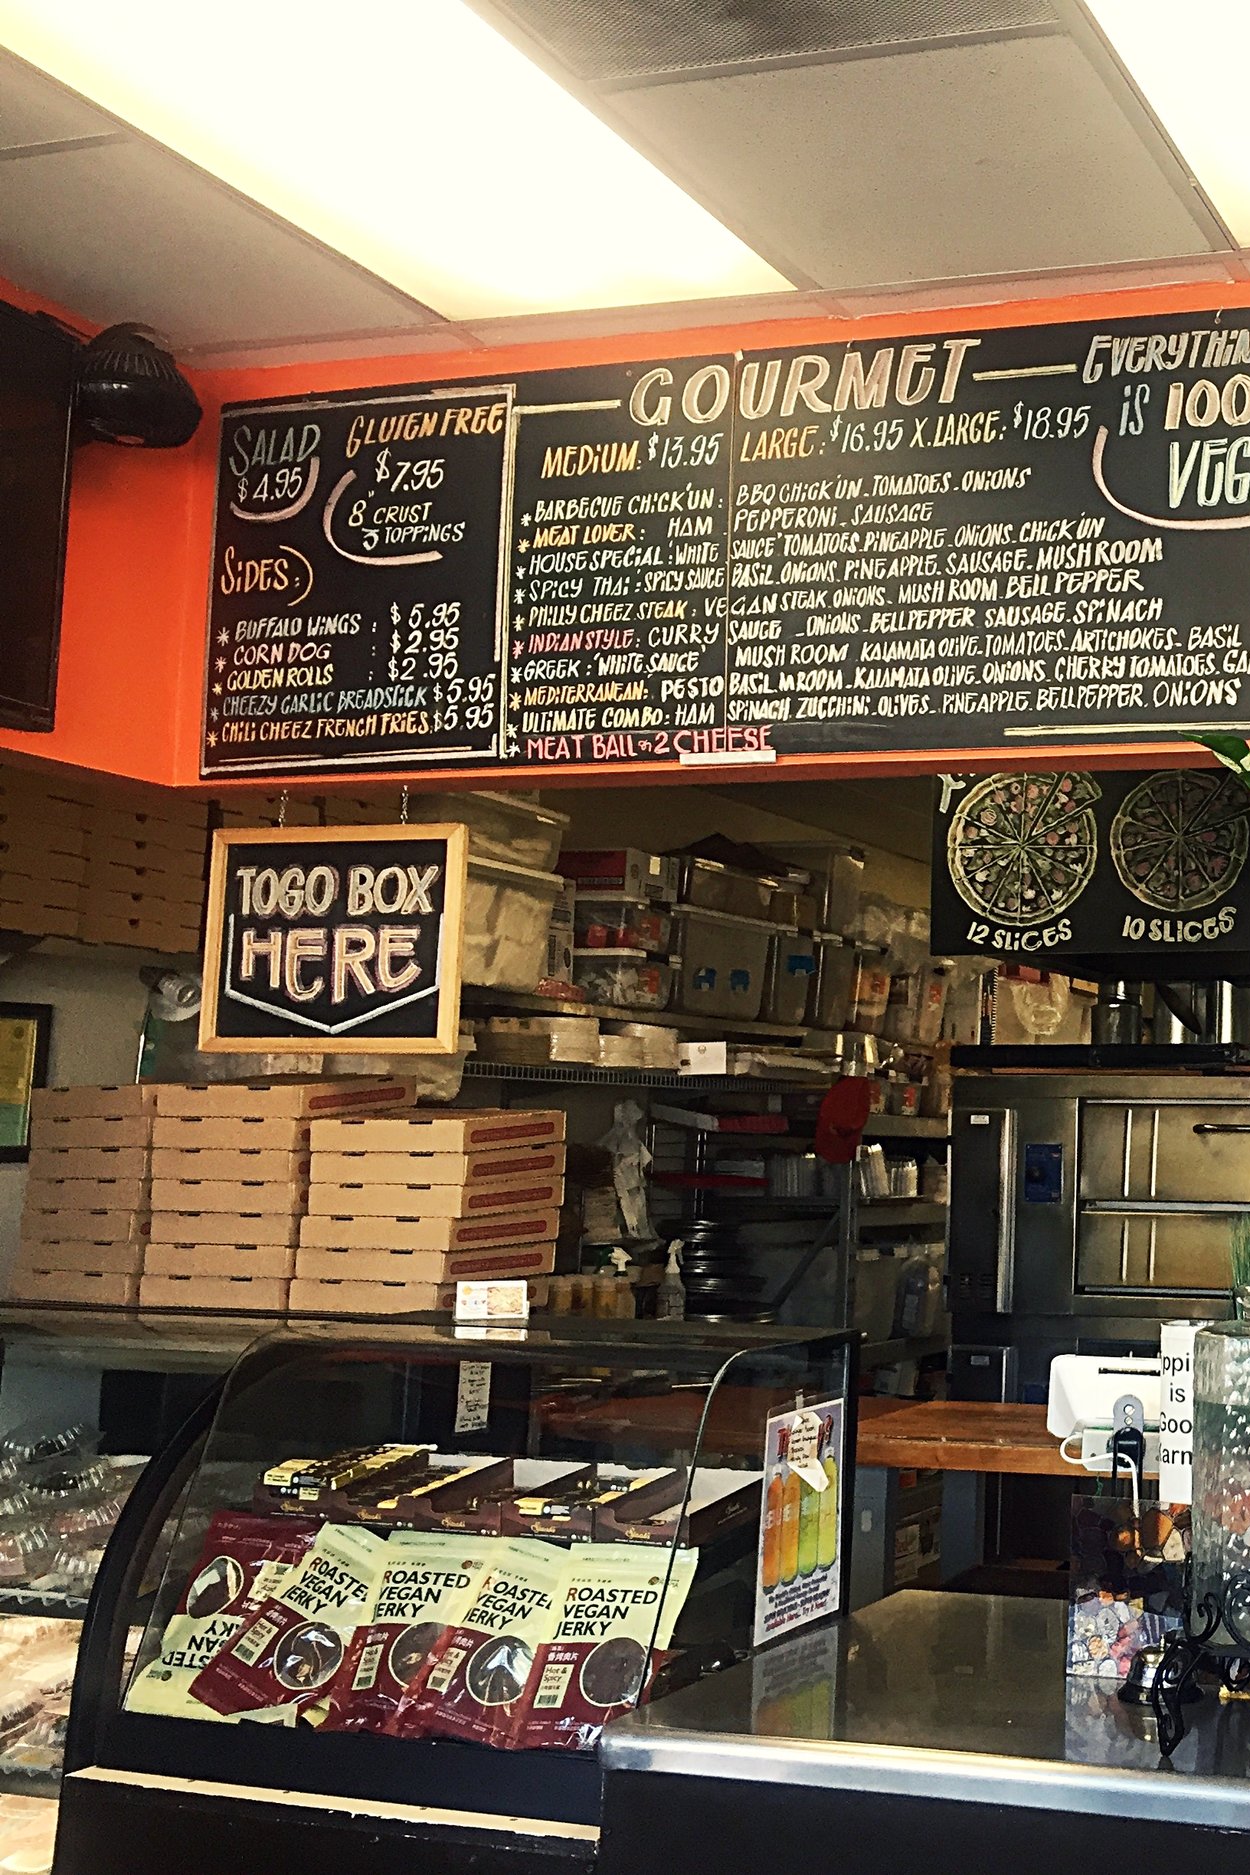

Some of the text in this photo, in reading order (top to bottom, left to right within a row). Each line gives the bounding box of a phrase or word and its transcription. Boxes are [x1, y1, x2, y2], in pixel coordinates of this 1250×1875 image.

[629, 338, 981, 427] GOURMET
[228, 423, 322, 476] SALAD
[345, 402, 508, 459] GLUTEN FREE
[648, 431, 725, 470] $13.95
[829, 411, 904, 454] $16.95
[1012, 400, 1092, 442] $18.95
[236, 466, 304, 502] $4.95
[374, 446, 446, 494] $7.95
[372, 501, 433, 525] CRUST
[533, 482, 777, 523] BARBECUE BBQ
[532, 500, 935, 550] MEAT HAM SAUSAGE
[529, 550, 589, 577] HOUSE
[684, 565, 726, 591] SAUCE
[580, 602, 634, 624] CHEEZ
[637, 599, 690, 621] STEAK
[704, 592, 778, 618] VEGAN
[1005, 574, 1053, 601] BELL
[1053, 567, 1145, 595] PEPPER
[234, 601, 462, 643] BUFFALO $5.95
[647, 623, 721, 649] CURRY
[232, 626, 460, 667] CORN DOG $2.95
[226, 652, 459, 692] GOLDEN ROLLS $2.95
[523, 658, 582, 681] GREEK
[660, 674, 725, 700] PESTO
[1053, 654, 1126, 682] CHERRY
[222, 673, 497, 717] CHEEZY $5.95
[674, 702, 716, 726] HAM
[259, 702, 494, 742] CHEEZ FRENCH $5.95
[526, 723, 776, 760] MEAT BALL 2 CHEESE
[236, 865, 440, 918] TOGO BOX
[965, 921, 988, 945] 12
[1121, 914, 1146, 940] 10
[240, 924, 422, 1004] HERE
[1169, 1381, 1187, 1404] is
[298, 1570, 350, 1609] VEGAN
[309, 1556, 370, 1603] ROASTE
[383, 1569, 472, 1590] ROASTED
[565, 1587, 659, 1605] ROASTED
[281, 1583, 329, 1615] JERKY
[371, 1601, 426, 1624] JERKY
[563, 1603, 630, 1621] VEGAN
[461, 1608, 514, 1632] JERKY
[552, 1620, 613, 1641] JERKY
